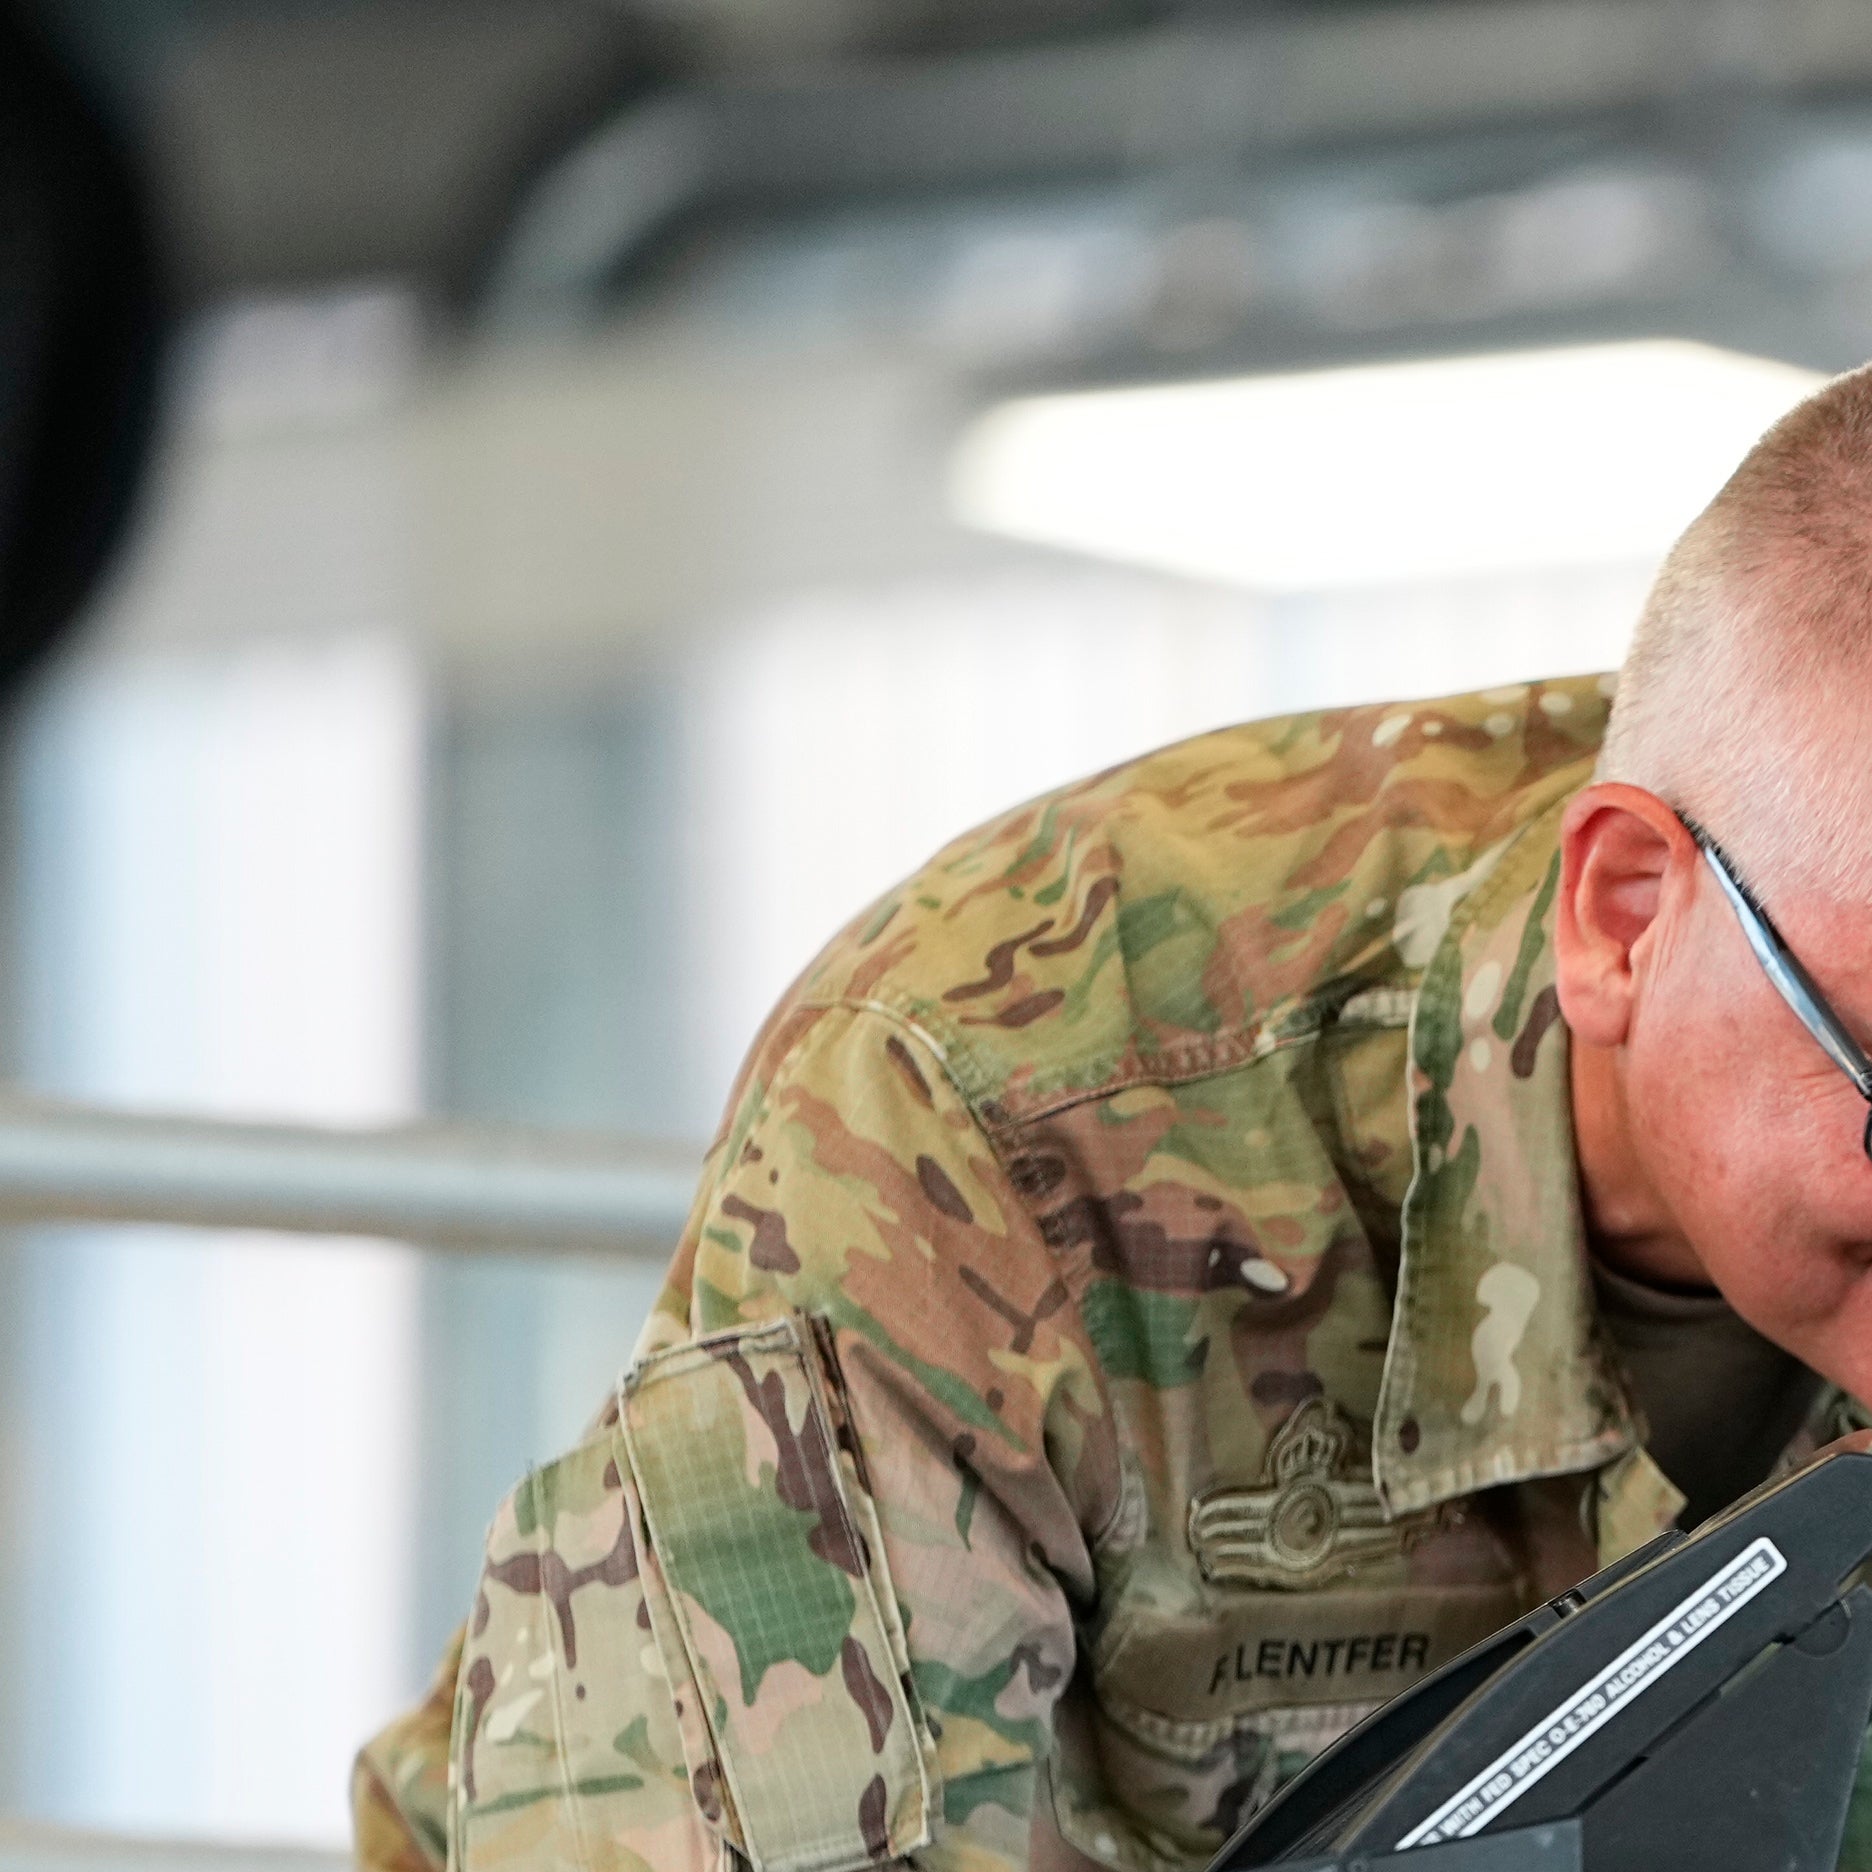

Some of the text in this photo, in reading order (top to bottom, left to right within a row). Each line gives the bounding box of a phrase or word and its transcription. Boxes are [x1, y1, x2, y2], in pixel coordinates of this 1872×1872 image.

[1479, 1772, 1513, 1803] FED
[1509, 1739, 1552, 1778] SPEC
[1605, 1642, 1672, 1700] ALCOHOL
[1680, 1597, 1721, 1635] LENS
[1717, 1555, 1771, 1602] TISSUE
